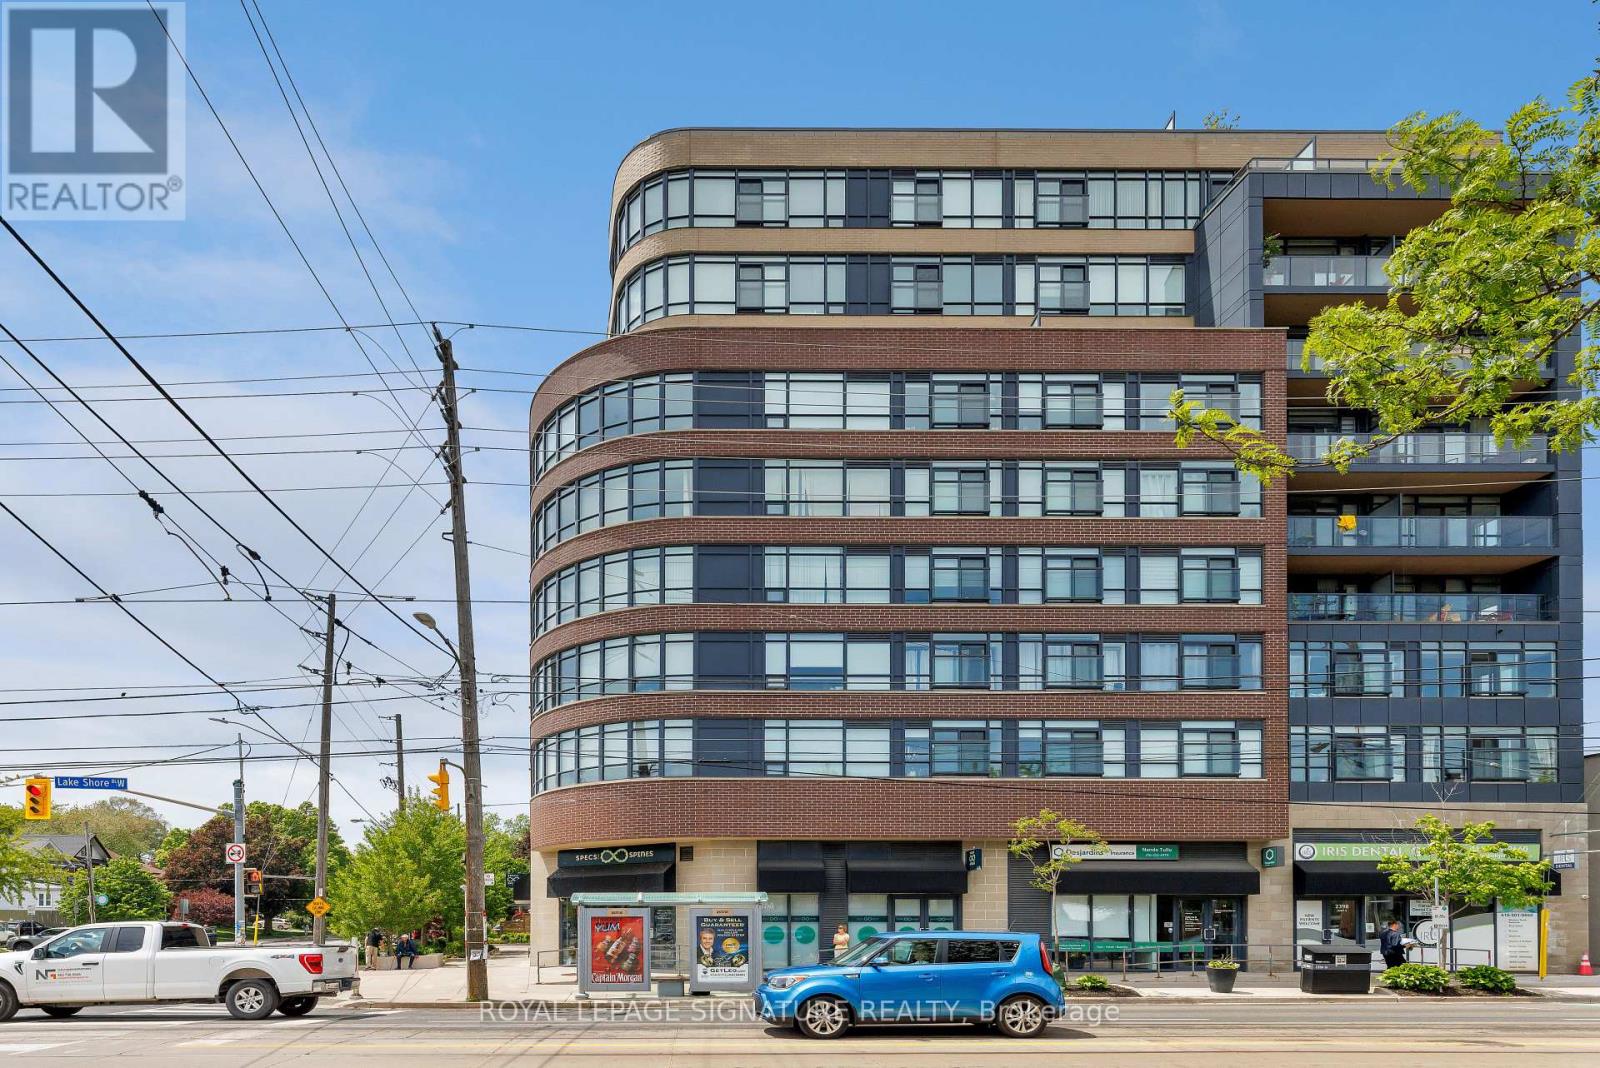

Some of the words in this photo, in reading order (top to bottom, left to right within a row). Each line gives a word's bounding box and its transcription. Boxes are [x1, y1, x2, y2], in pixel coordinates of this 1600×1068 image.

[57, 778, 79, 787] Lake
[82, 779, 110, 787] Shore
[116, 780, 125, 788] W
[1322, 846, 1348, 857] IRIS
[1351, 846, 1403, 857] DENTAL
